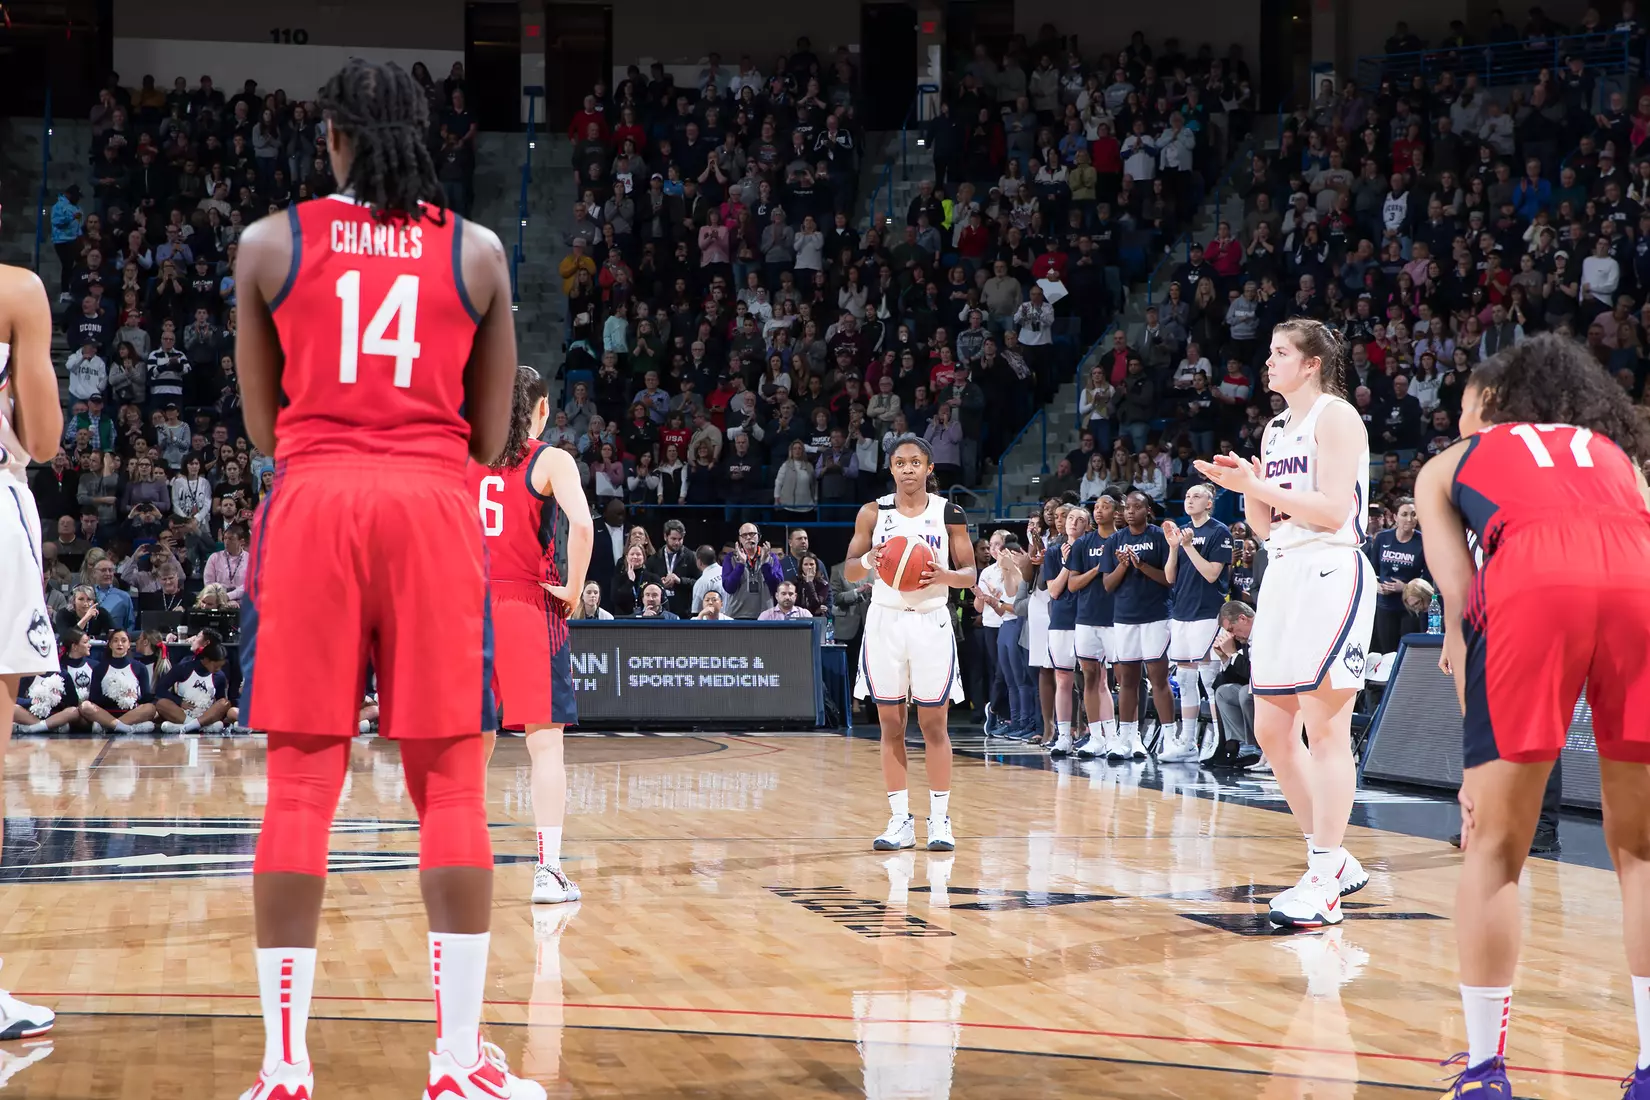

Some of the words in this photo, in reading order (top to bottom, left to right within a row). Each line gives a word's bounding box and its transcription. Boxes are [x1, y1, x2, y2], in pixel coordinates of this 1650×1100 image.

[270, 28, 308, 45] 110
[331, 220, 423, 259] CHARLES
[80, 324, 102, 333] UCONN
[336, 270, 421, 388] 14
[665, 435, 684, 443] USA
[1509, 423, 1594, 467] 17
[1264, 455, 1308, 479] CONN
[478, 475, 504, 536] 6
[1382, 550, 1415, 563] UCONN
[629, 656, 748, 668] ORTHOPEDICS
[753, 656, 764, 668] &
[629, 674, 695, 687] SPORTS
[699, 675, 780, 687] MEDICINE
